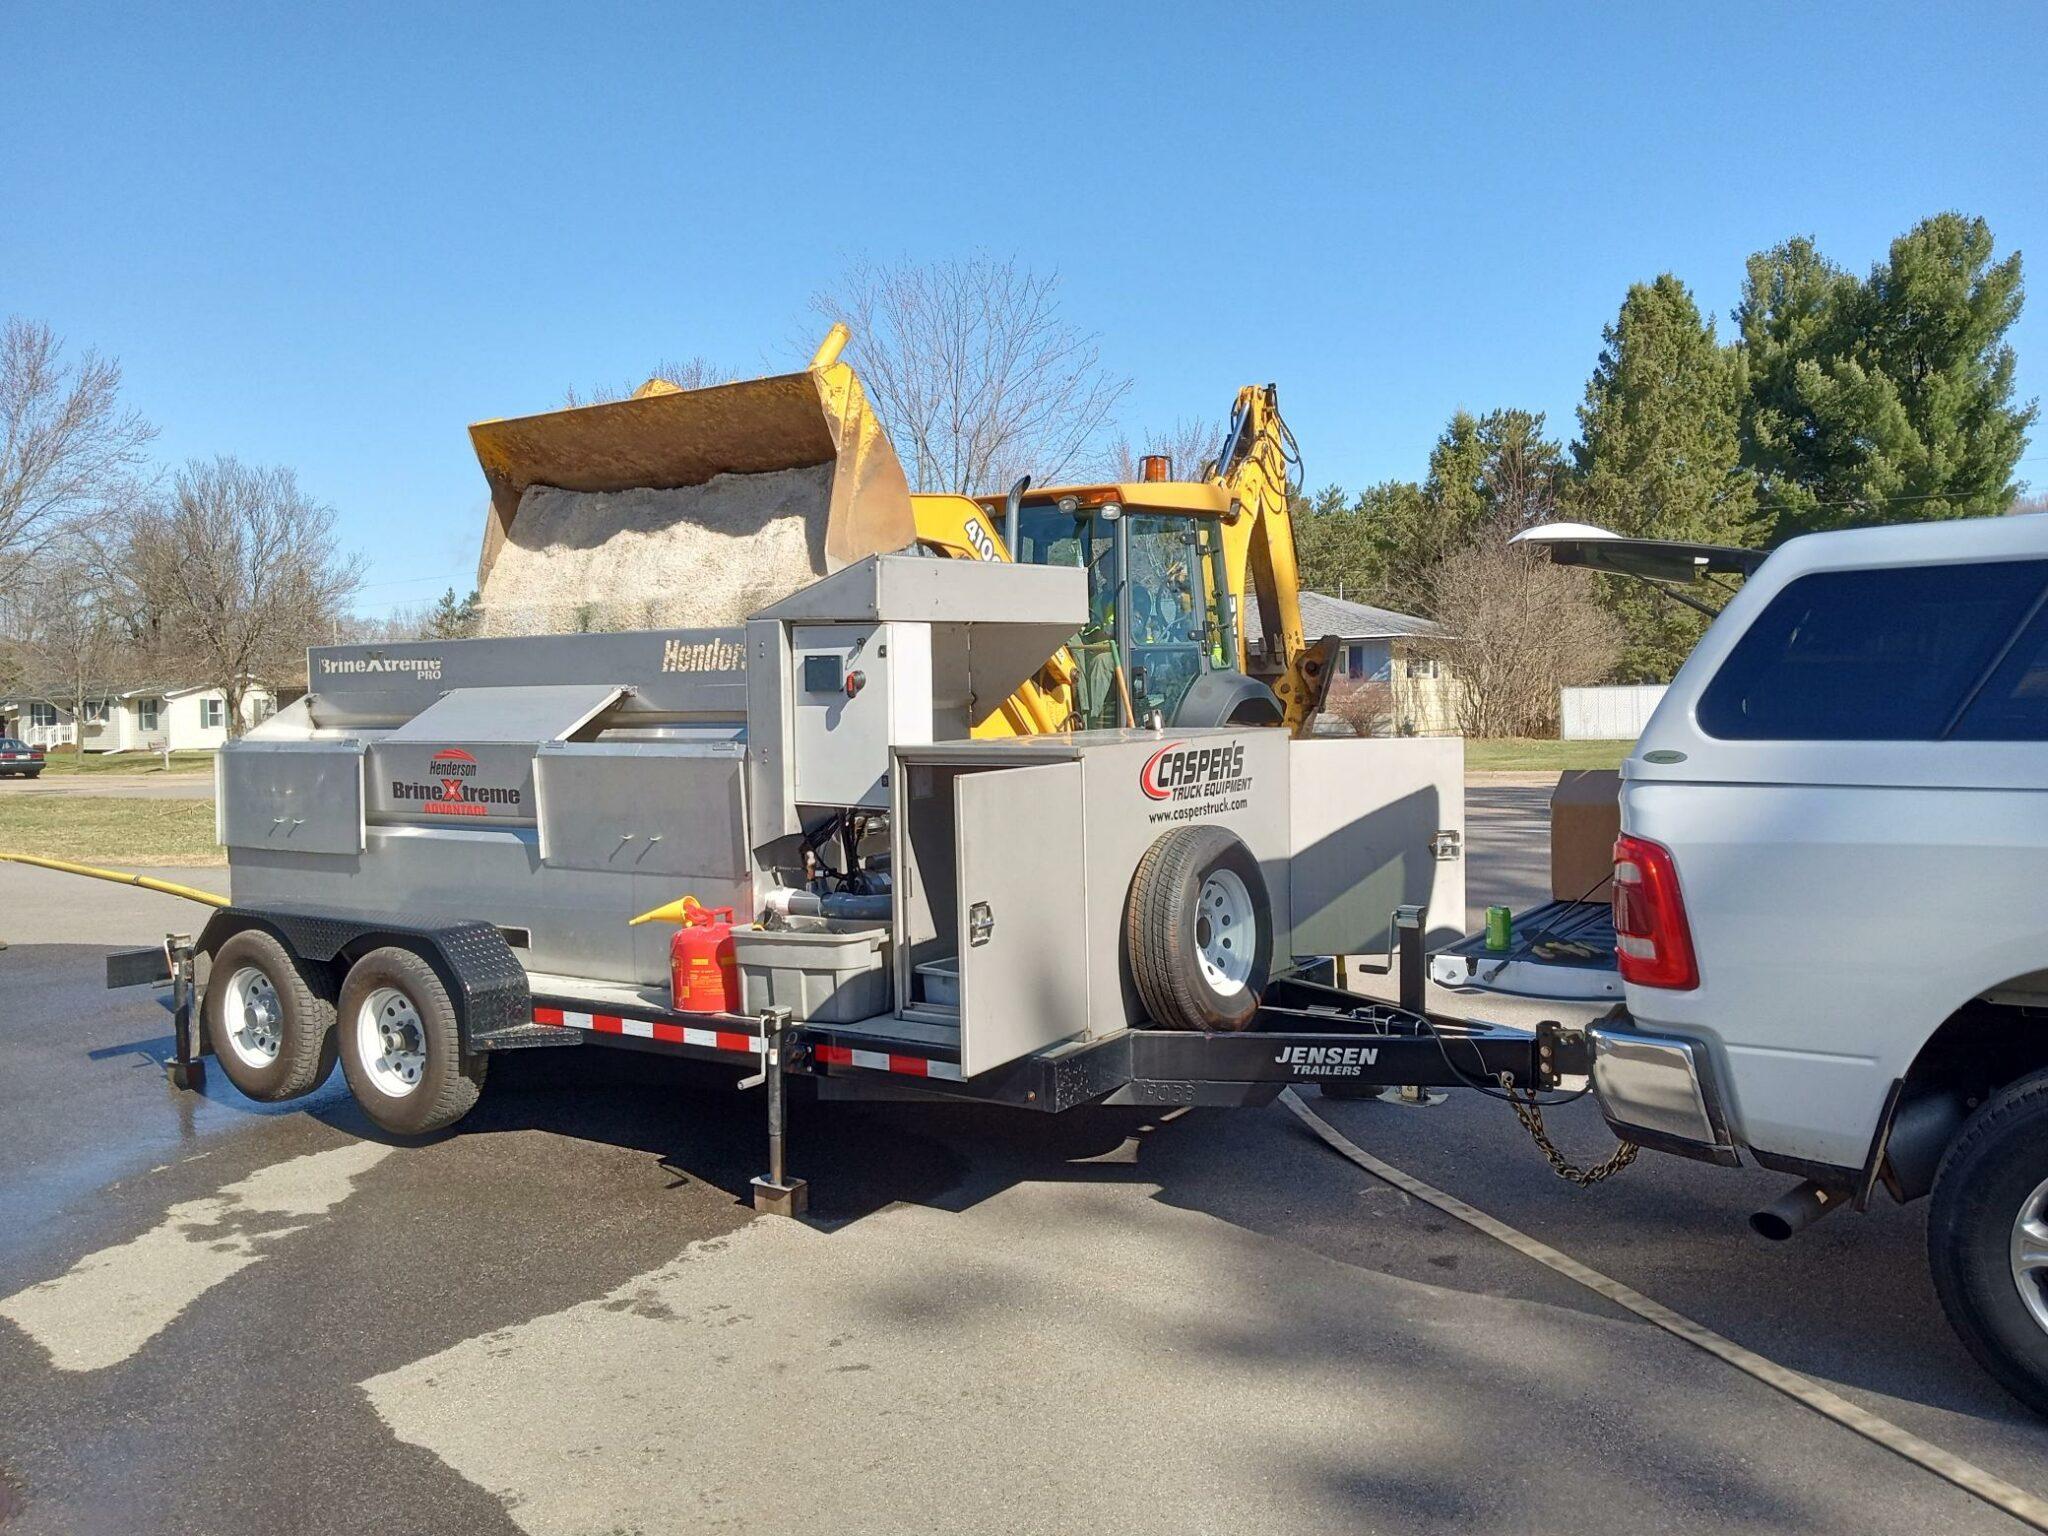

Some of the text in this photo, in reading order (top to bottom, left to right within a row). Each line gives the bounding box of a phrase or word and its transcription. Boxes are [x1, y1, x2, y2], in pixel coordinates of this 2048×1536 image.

[964, 518, 1002, 562] 410
[417, 670, 442, 681] PRO
[429, 761, 477, 777] Henderson
[1157, 740, 1245, 788] CASPER'S
[392, 779, 521, 805] BrineXtreme
[1172, 777, 1253, 802] TRUCK EQUIPMENT
[1149, 798, 1248, 825] www.casperstruck.com
[1275, 1046, 1379, 1065] JENSEN
[1292, 1065, 1361, 1076] TRAILERS
